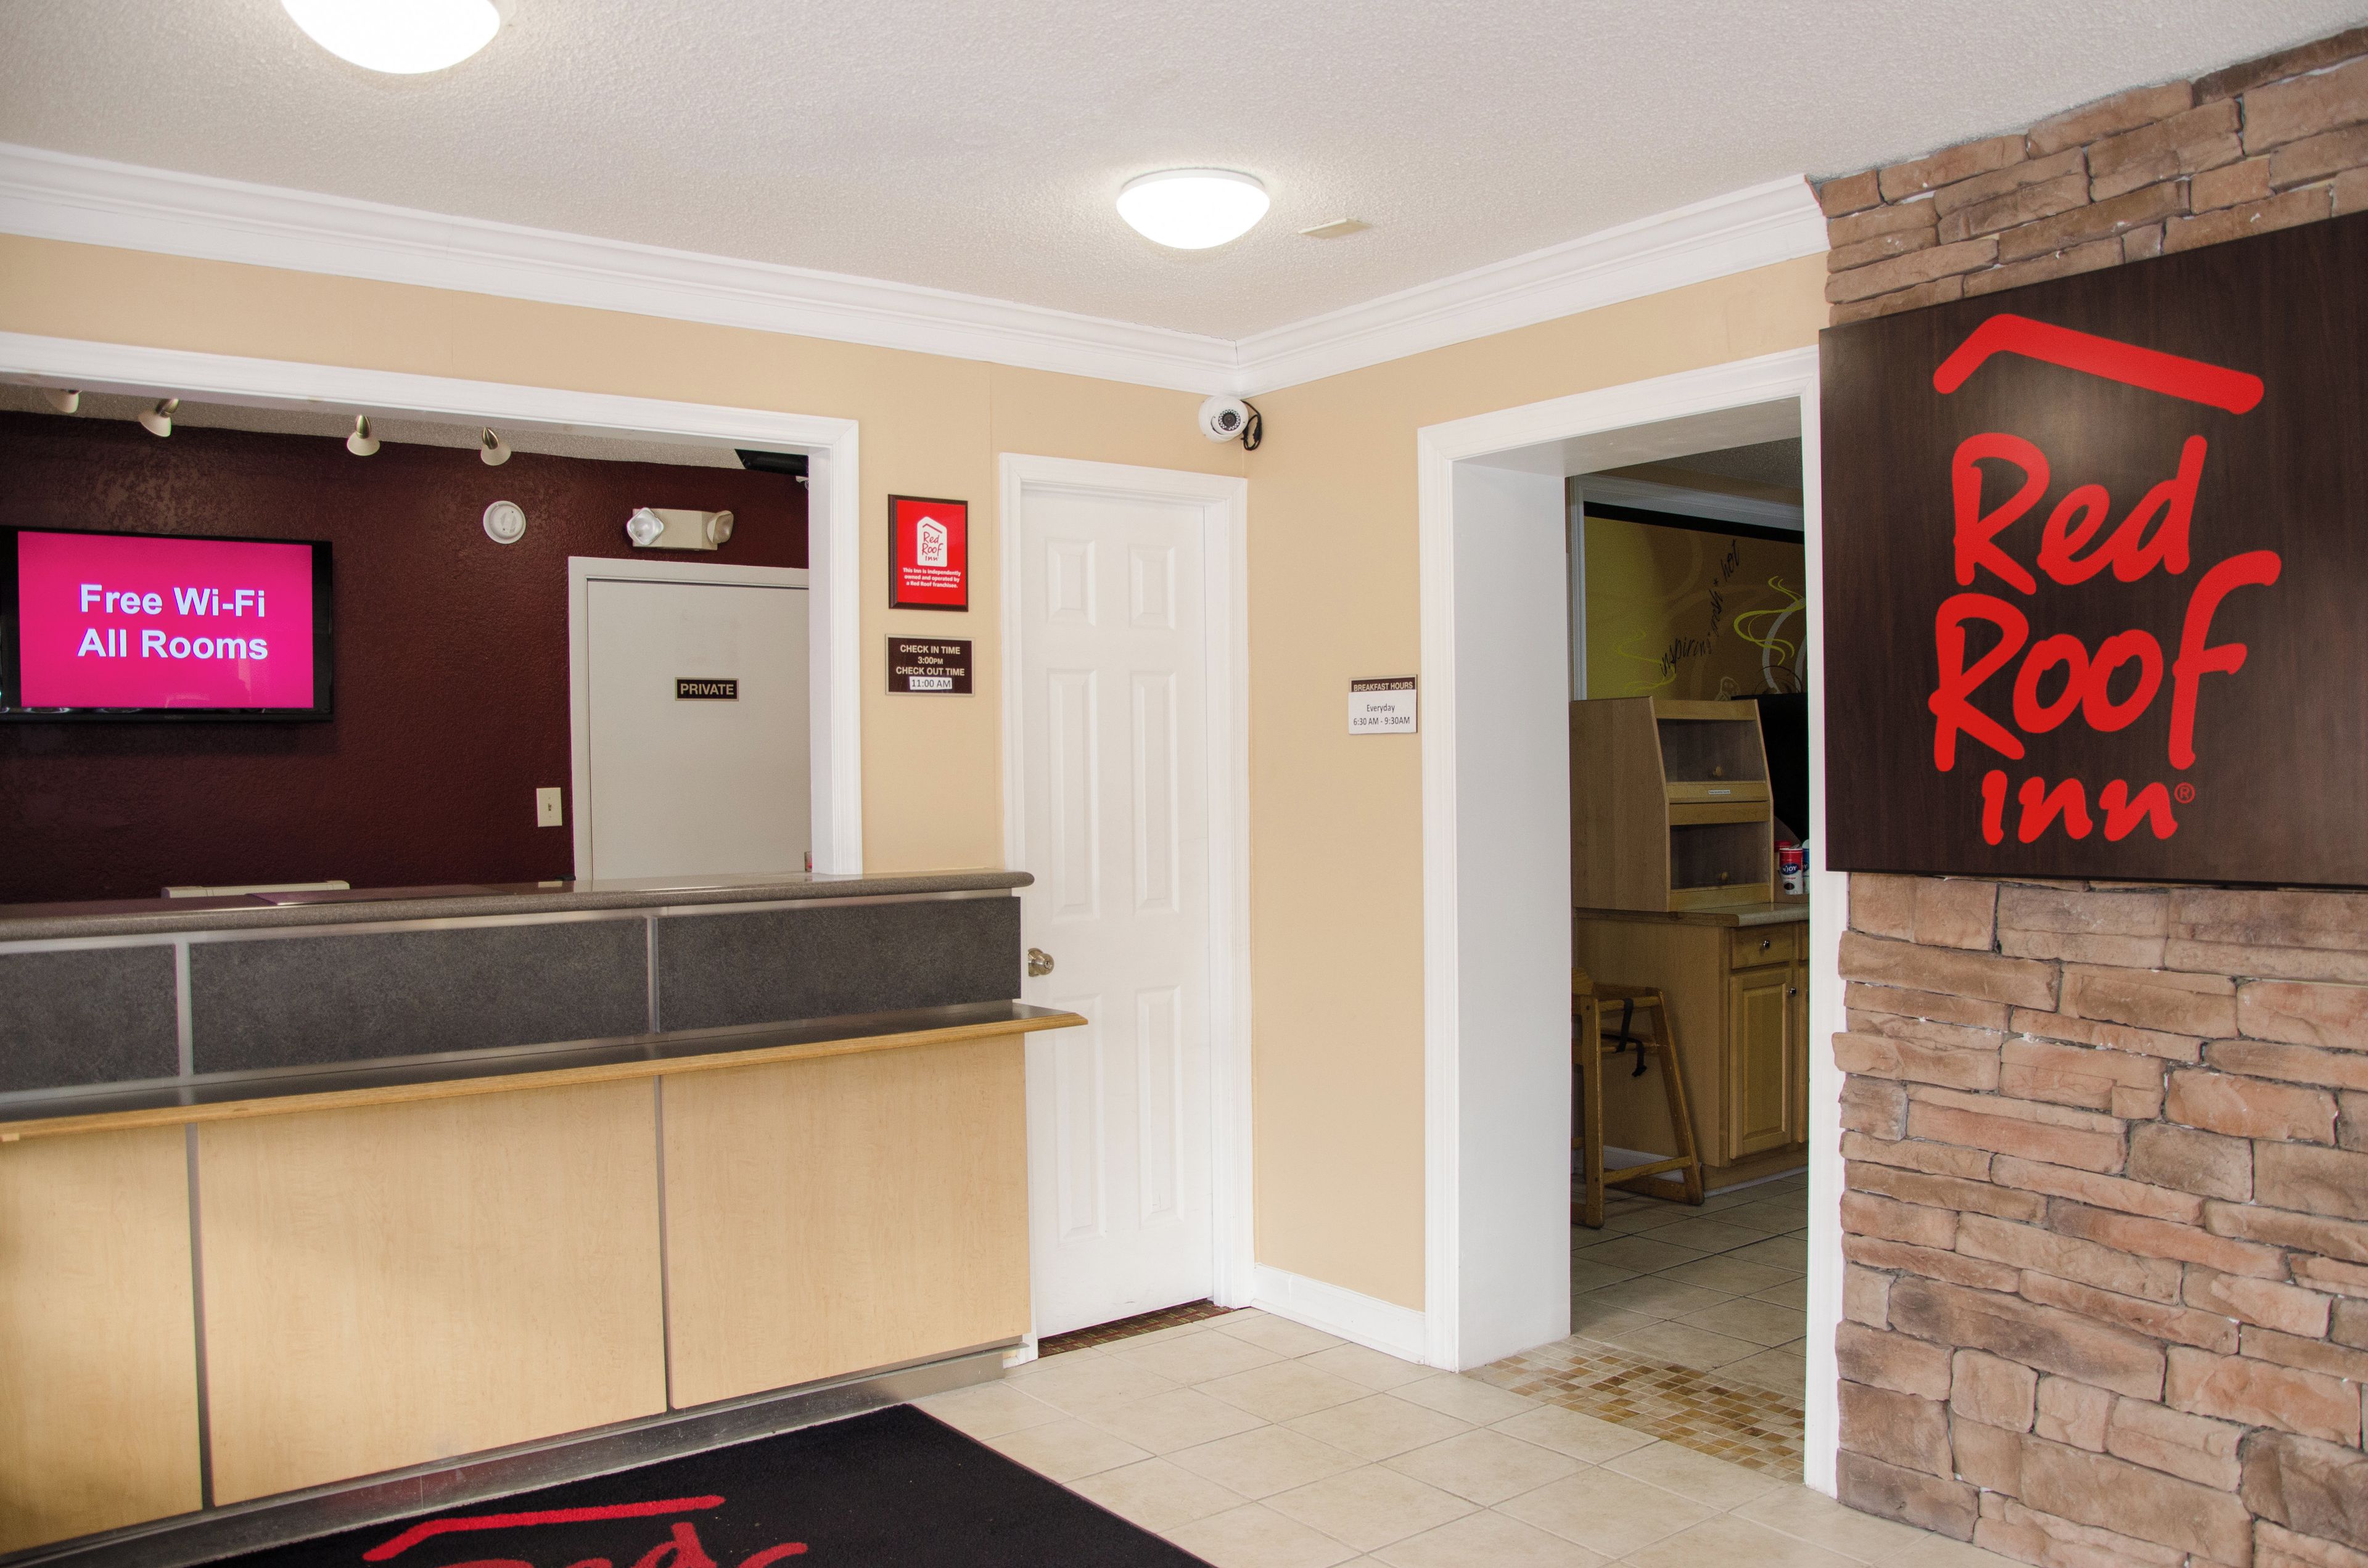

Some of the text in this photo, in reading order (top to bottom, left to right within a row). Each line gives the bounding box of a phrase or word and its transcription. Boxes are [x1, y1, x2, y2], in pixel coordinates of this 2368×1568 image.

[1952, 432, 2208, 595] Red
[923, 532, 940, 544] Red
[922, 543, 944, 557] Roof
[1720, 538, 1740, 582] hot
[927, 569, 961, 577] independently
[81, 583, 265, 617] Free Wi-Fi
[77, 628, 268, 660] All Rooms
[900, 644, 961, 655] CHECK IN TIME
[918, 656, 944, 665] 3:00PM
[1928, 550, 2282, 772] Roof
[896, 667, 965, 676] CHECK OUT TIME
[680, 683, 734, 695] PRIVATE
[912, 679, 934, 688] 11:00
[1354, 681, 1413, 692] BREAKFAST HOURS
[1367, 704, 1395, 713] Everyday
[1354, 718, 1367, 726] 6:30
[1368, 717, 1379, 725] AM
[1384, 716, 1410, 725] 9:30AM
